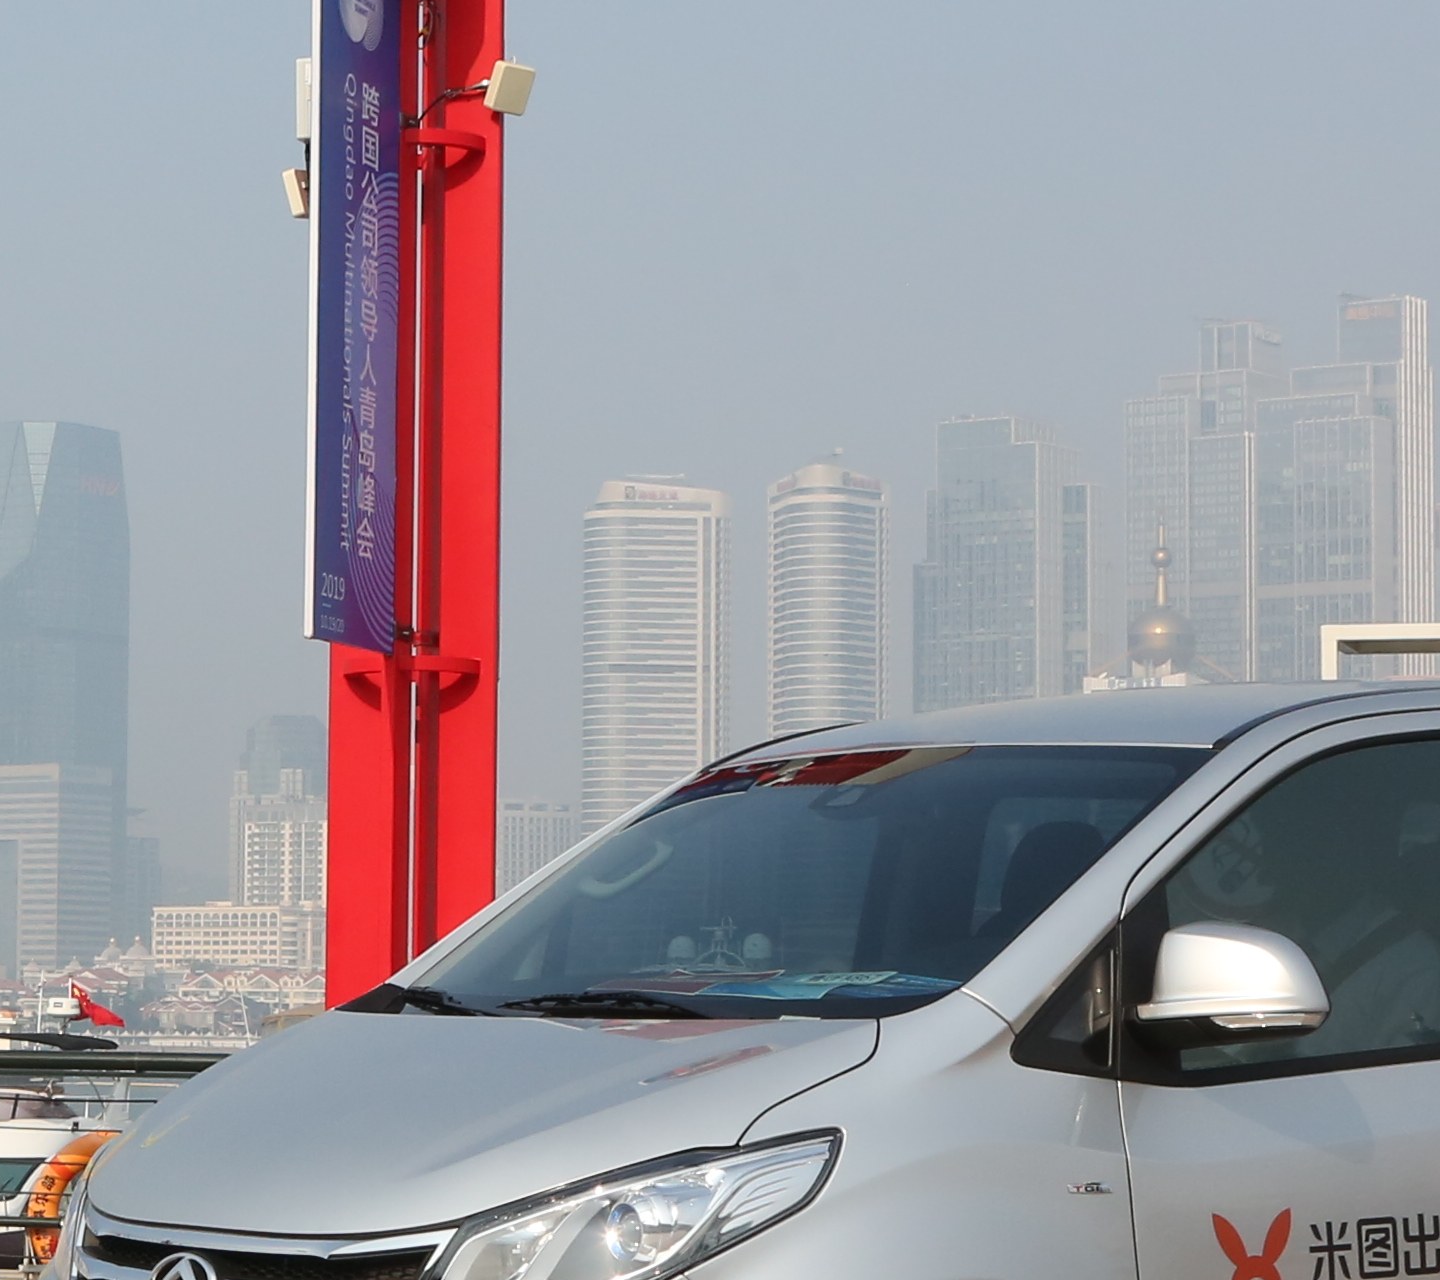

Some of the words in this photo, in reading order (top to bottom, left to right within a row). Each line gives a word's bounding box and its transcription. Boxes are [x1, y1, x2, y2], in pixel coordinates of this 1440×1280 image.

[343, 73, 357, 202] Qingdao
[342, 211, 357, 426] Multinationals
[340, 435, 353, 551] Summit
[321, 572, 345, 601] 2019
